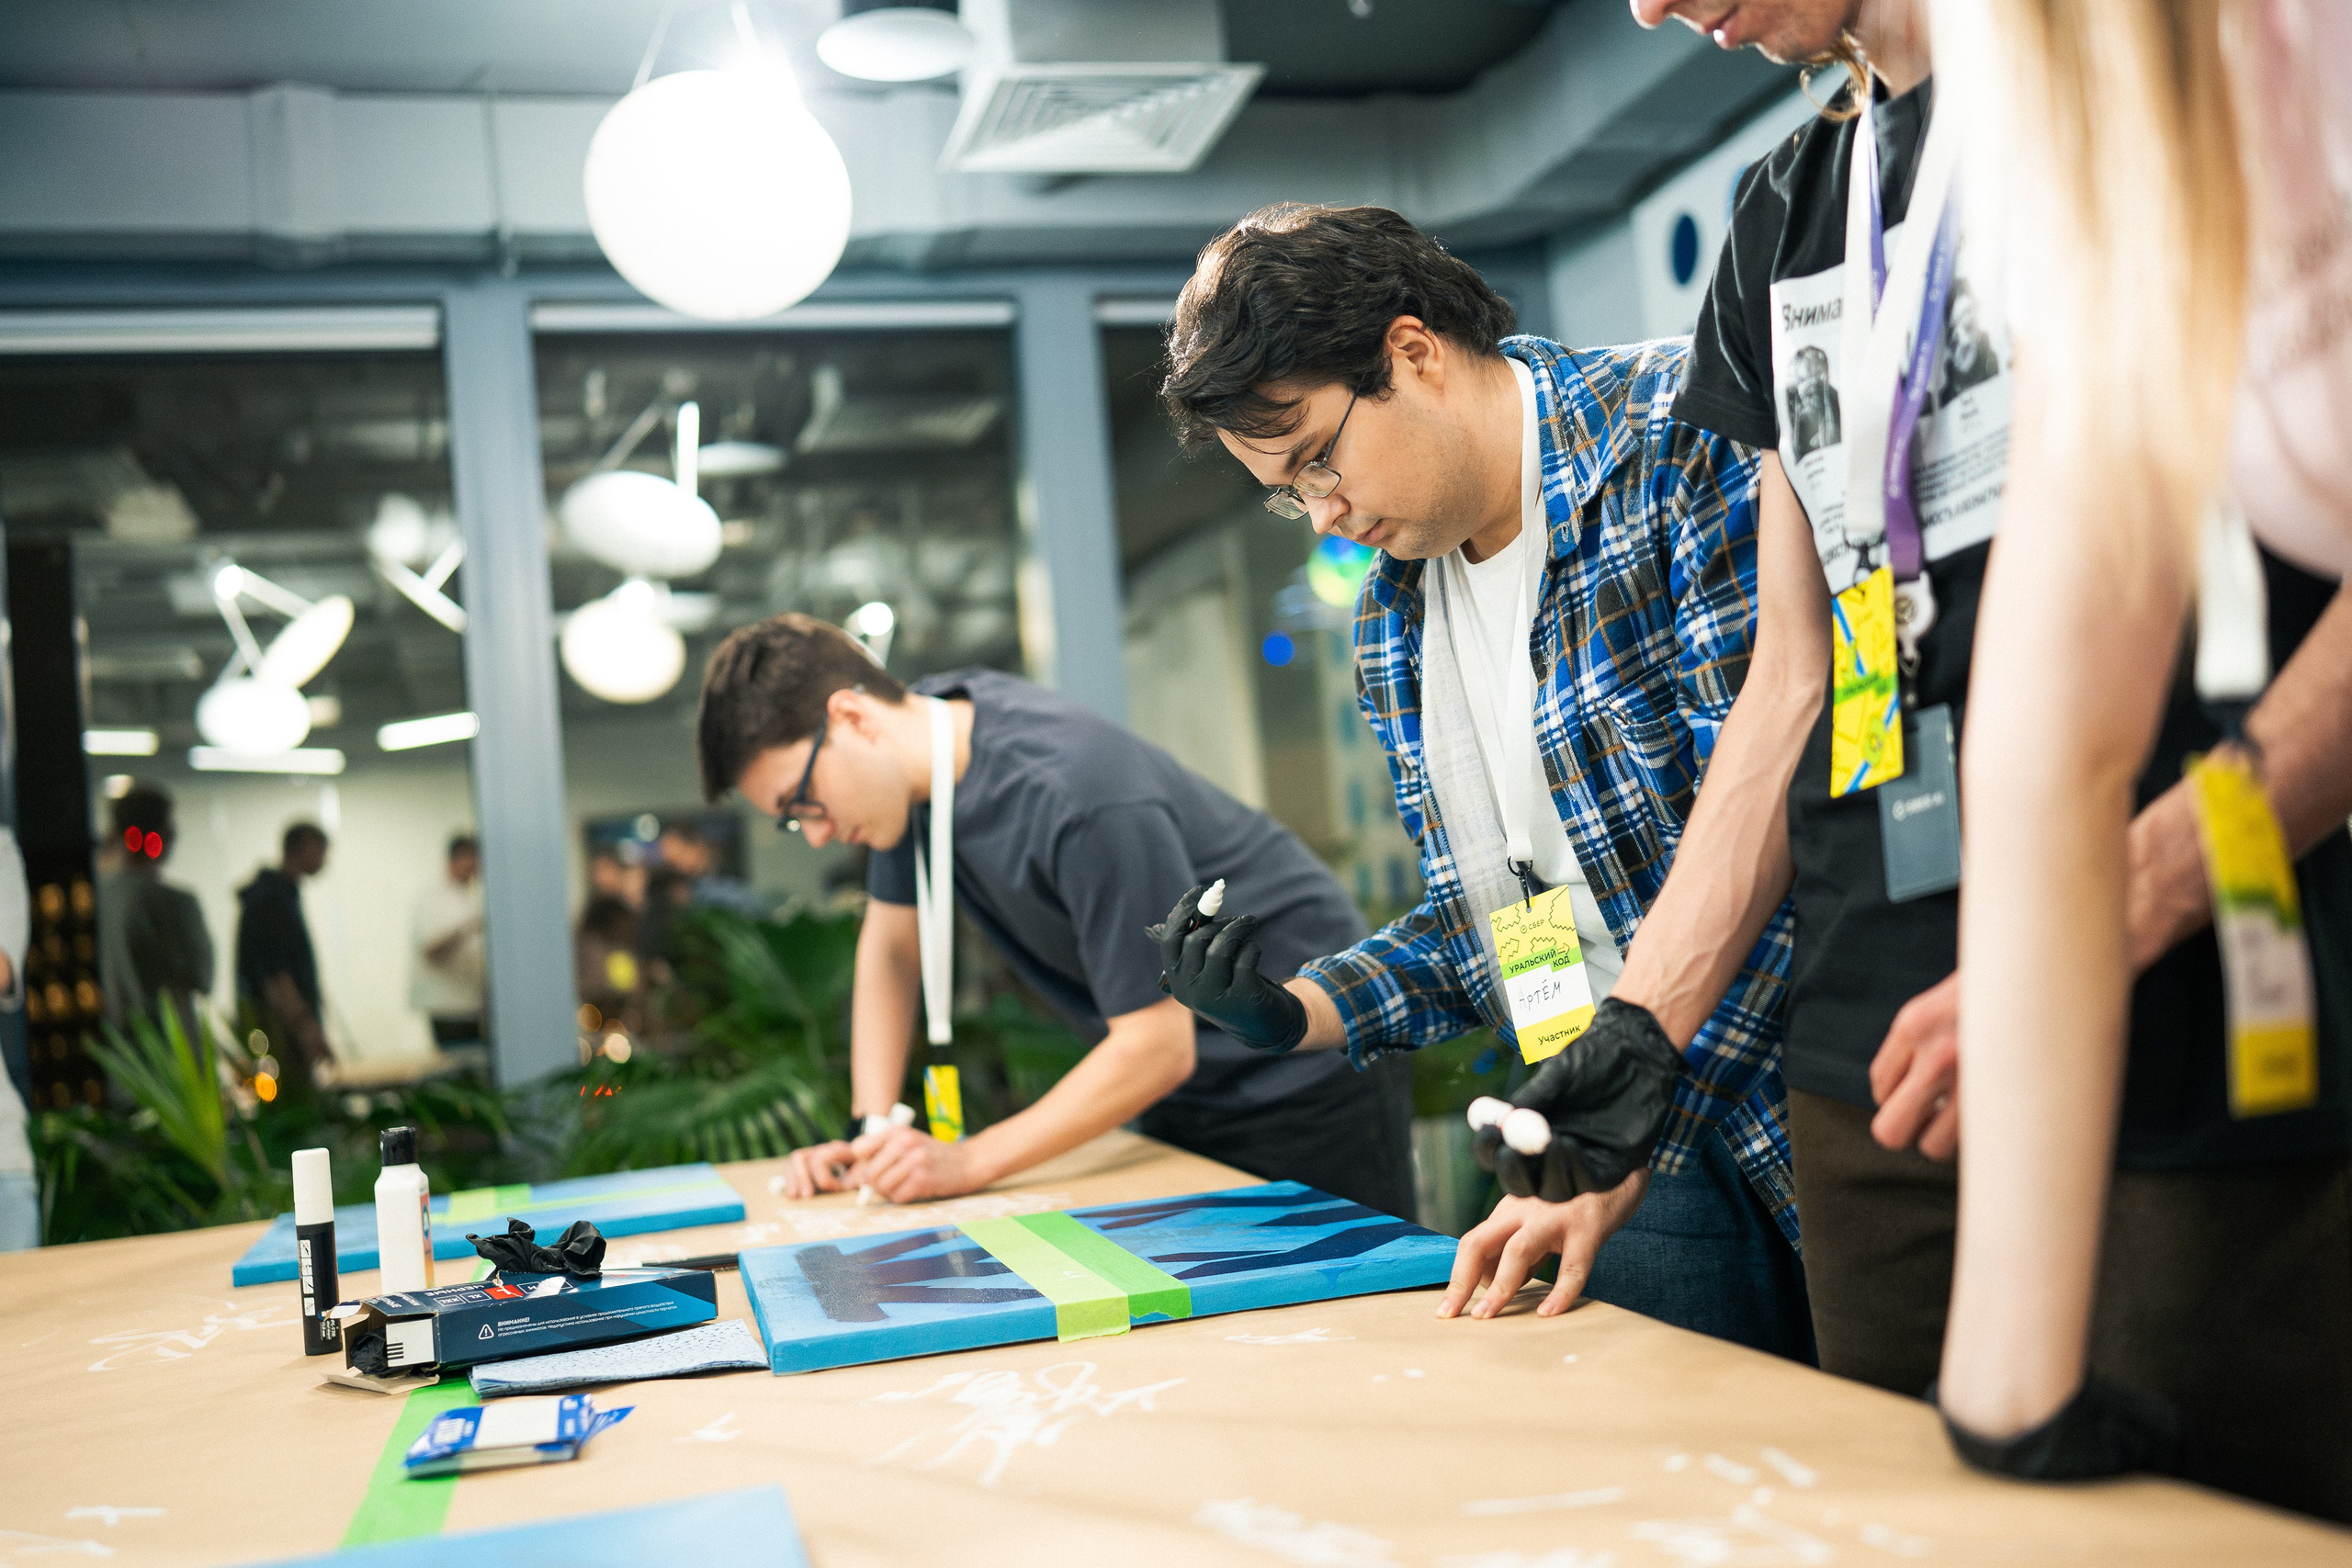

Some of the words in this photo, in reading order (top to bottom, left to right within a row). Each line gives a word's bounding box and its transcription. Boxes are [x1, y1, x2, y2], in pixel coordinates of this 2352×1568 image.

[1528, 919, 1544, 931] СБЕР
[1509, 948, 1557, 974] УРАЛЬСКИЙ
[1552, 955, 1571, 968] КОД
[1538, 1024, 1581, 1045] Участник
[497, 1316, 530, 1327] ВНИМАНИЕ!
